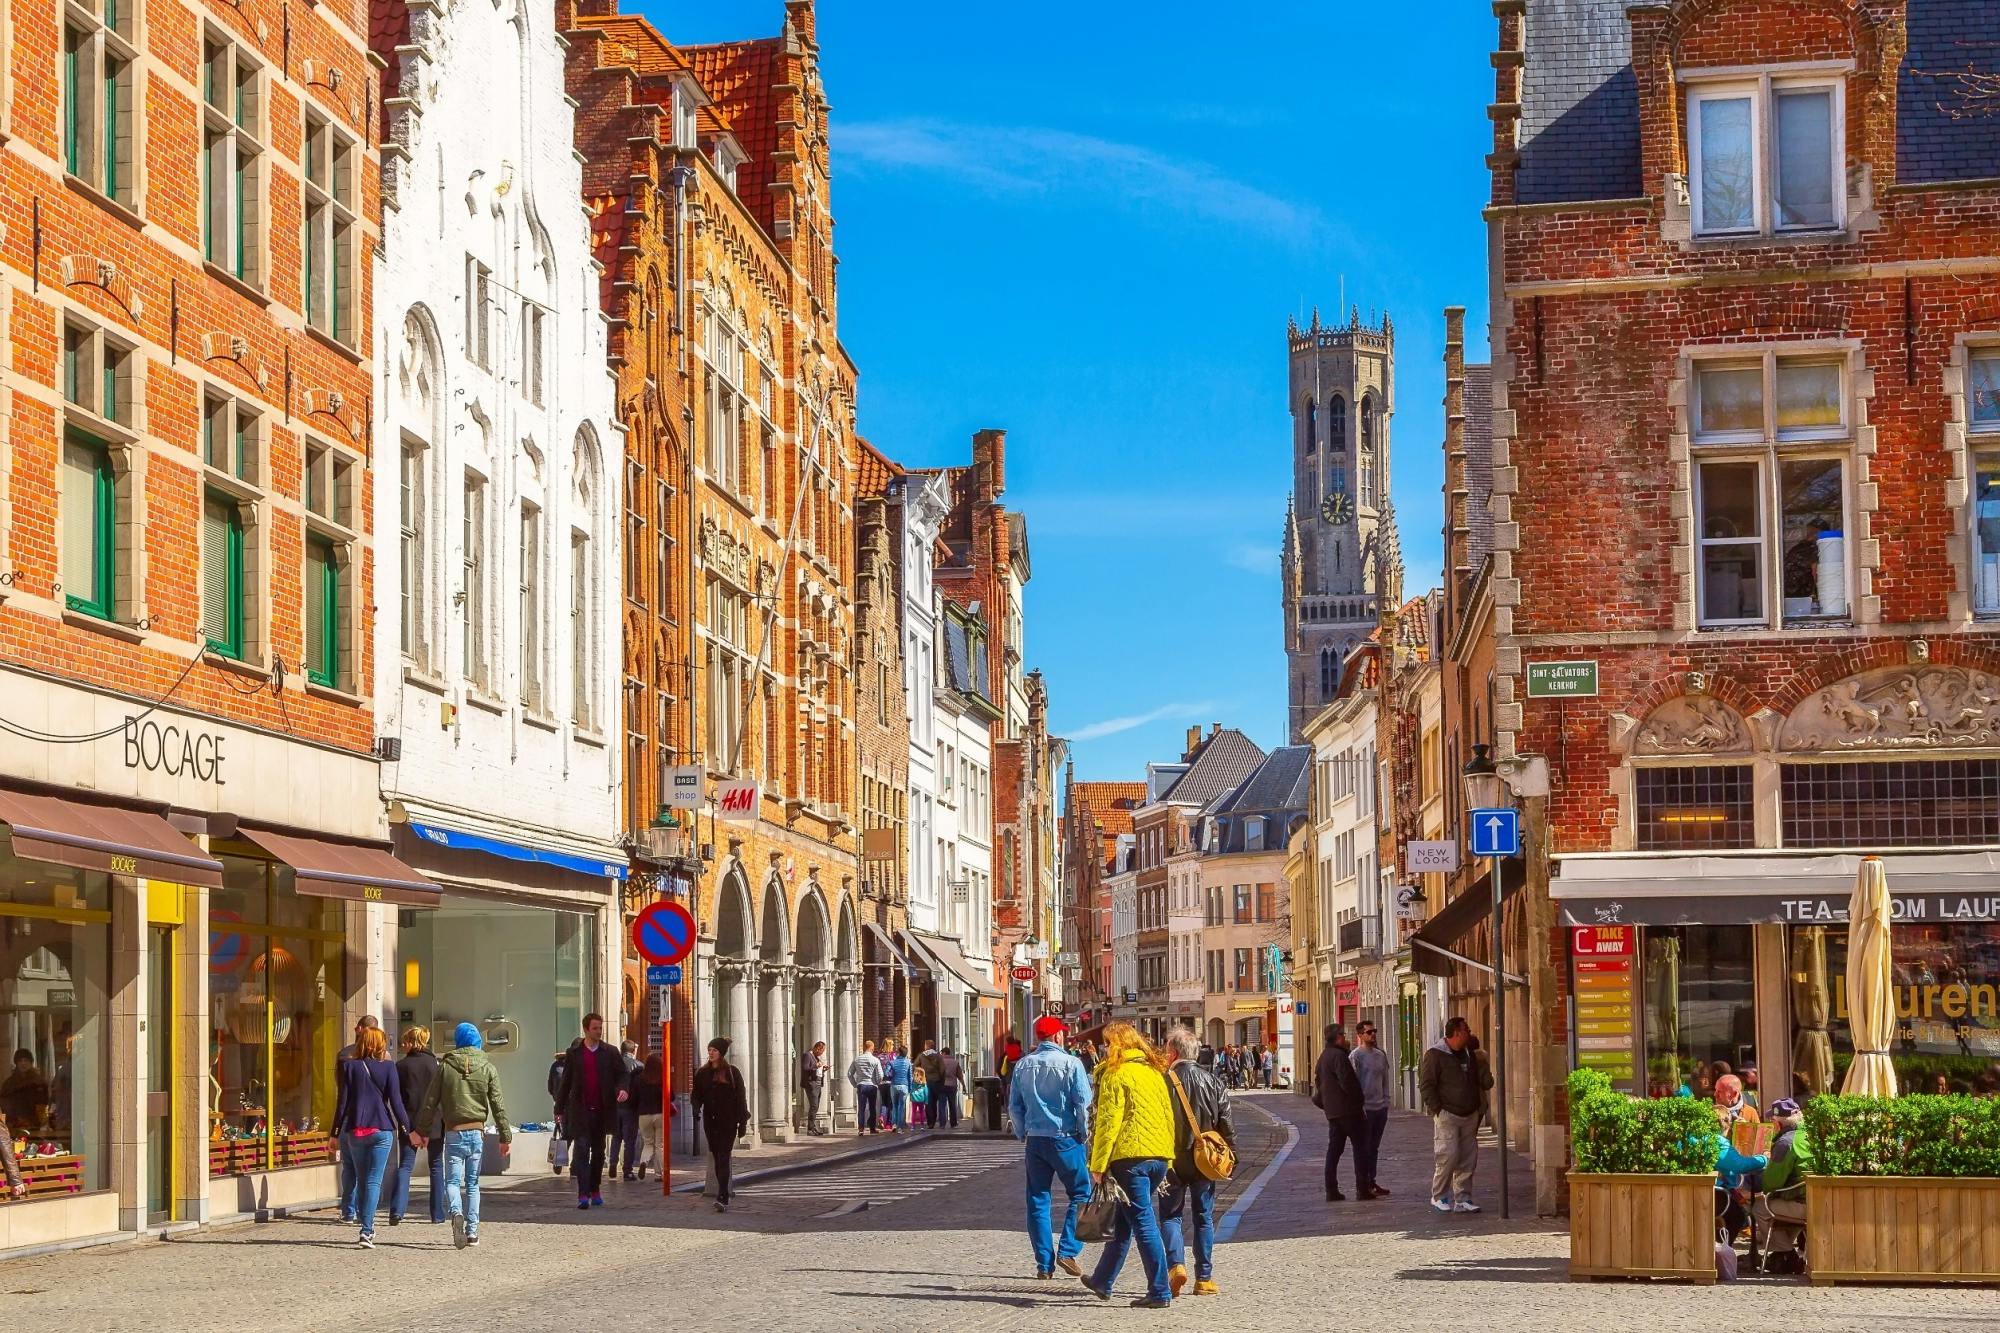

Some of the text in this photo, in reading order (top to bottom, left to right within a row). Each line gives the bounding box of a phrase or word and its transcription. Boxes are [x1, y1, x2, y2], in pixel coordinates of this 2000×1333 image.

[1548, 681, 1578, 690] KERKHOF
[124, 715, 226, 785] BOCAGE
[675, 791, 696, 800] shop
[721, 788, 754, 811] H&M
[111, 856, 136, 873] BOCAGE
[364, 887, 382, 900] BOCAGE
[1781, 898, 1926, 919] TEA-OM
[1595, 927, 1624, 939] TAKE
[1595, 942, 1624, 952] AWAY
